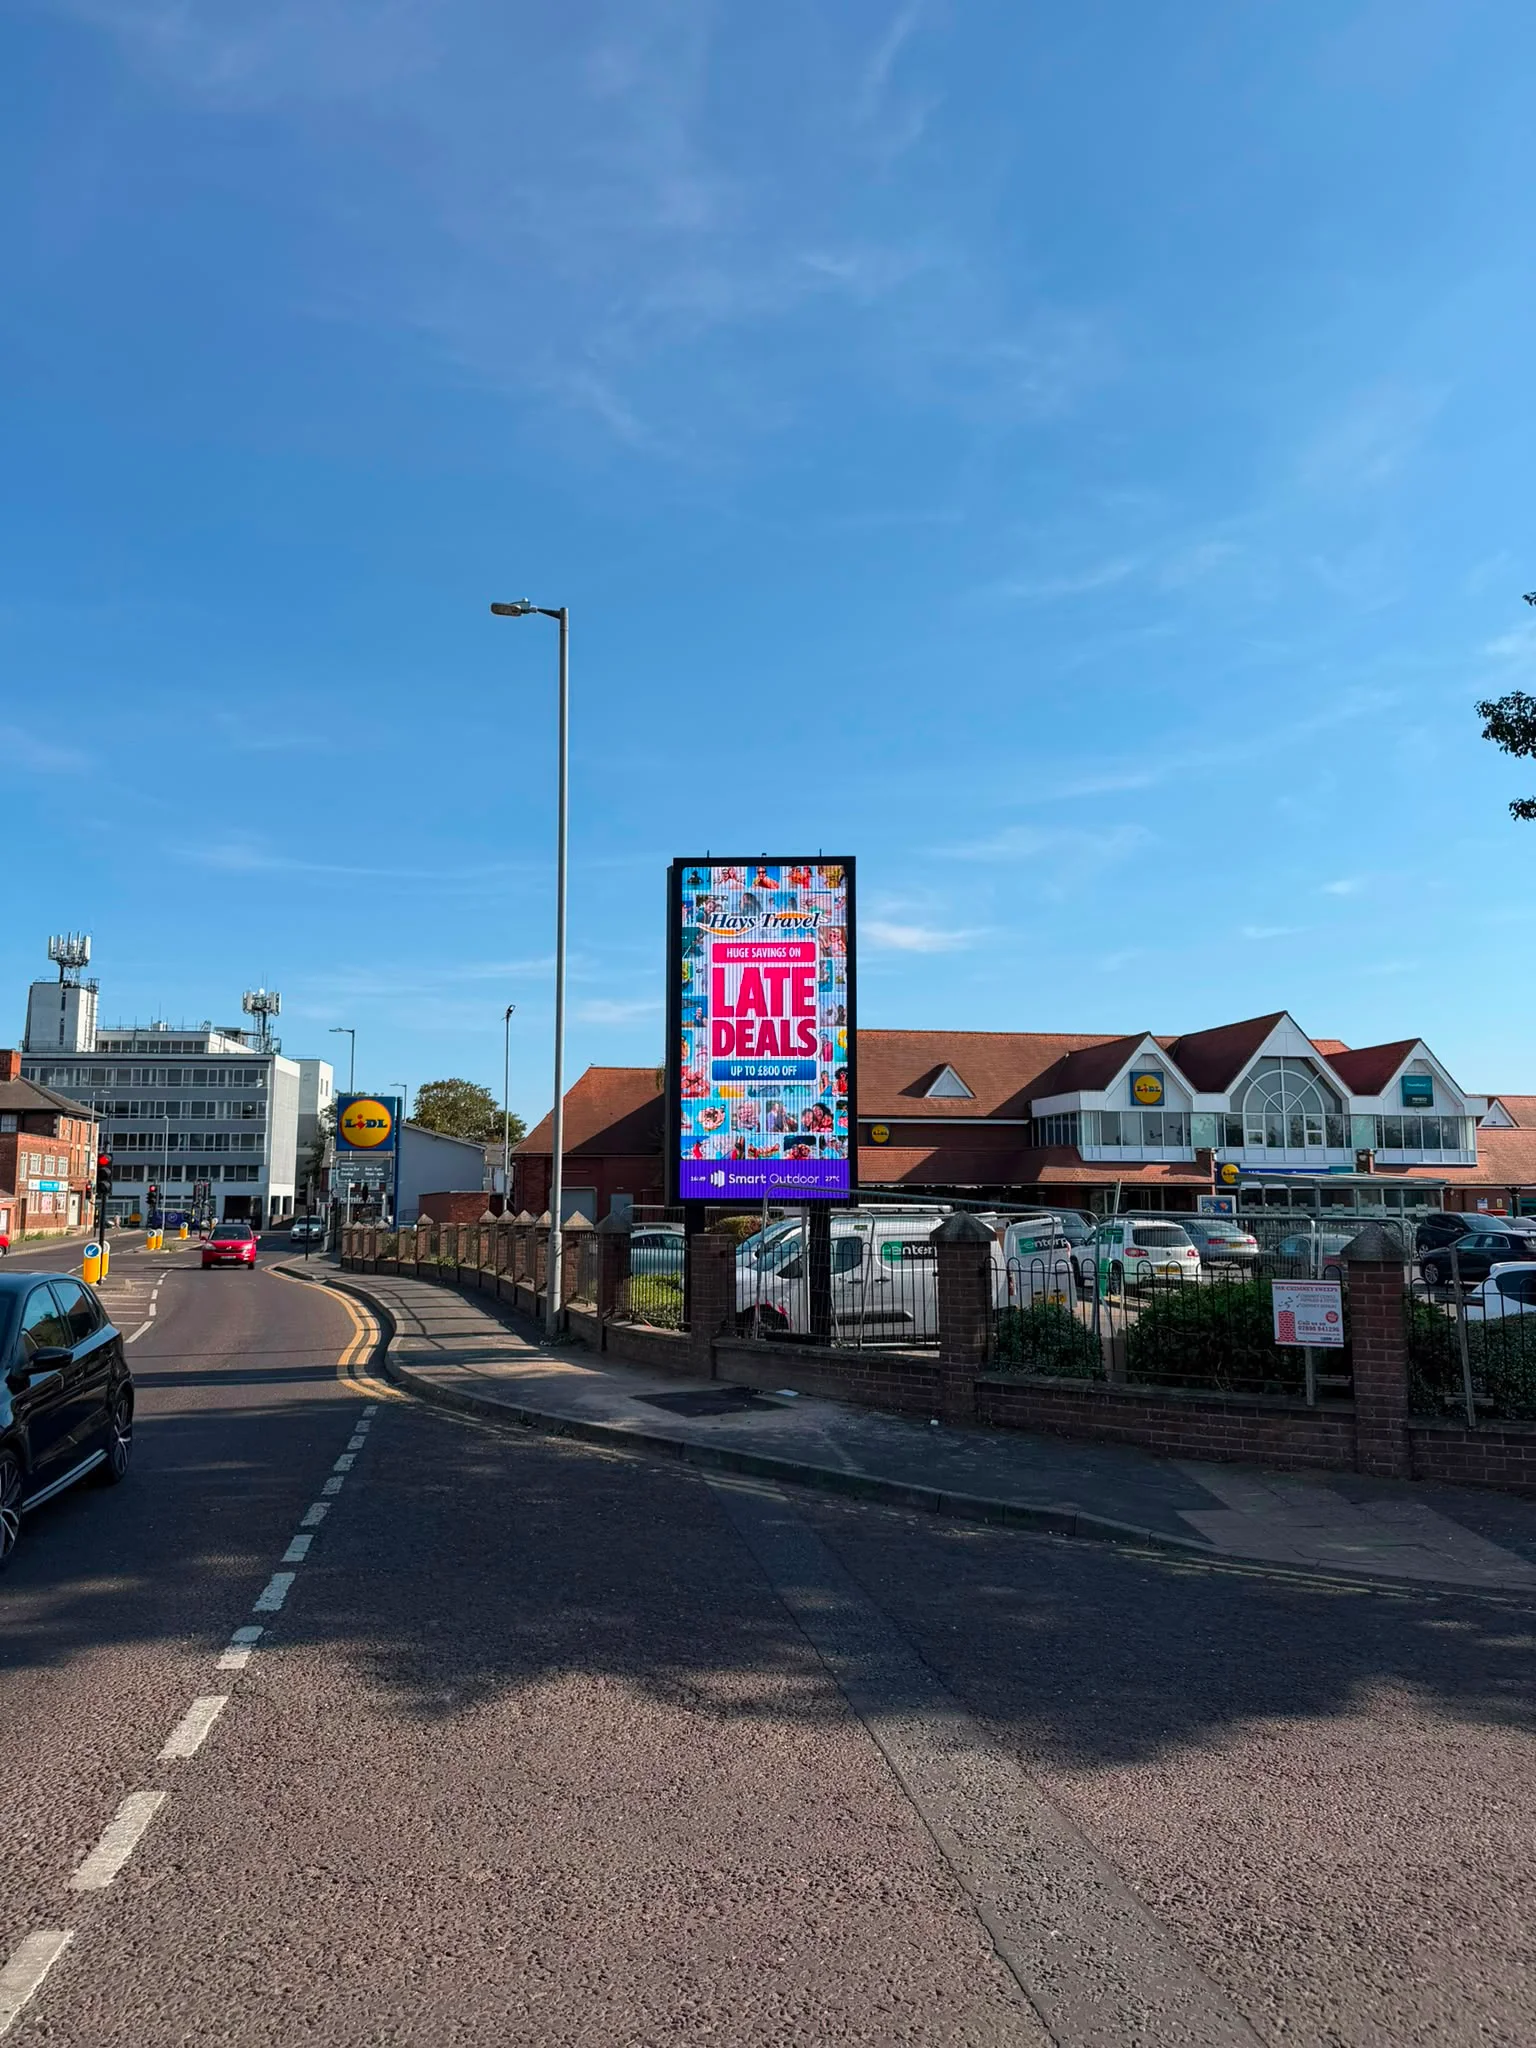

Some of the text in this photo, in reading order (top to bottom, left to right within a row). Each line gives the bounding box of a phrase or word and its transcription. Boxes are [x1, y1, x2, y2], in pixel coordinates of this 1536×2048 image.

[710, 912, 820, 932] Hays Travel
[727, 947, 802, 958] HUGE SAVINGS ON
[712, 967, 816, 1017] LATE
[712, 1019, 818, 1057] DEALS
[730, 1066, 798, 1076] UP TO £800 OFF
[729, 1173, 820, 1184] Smart Outdoor
